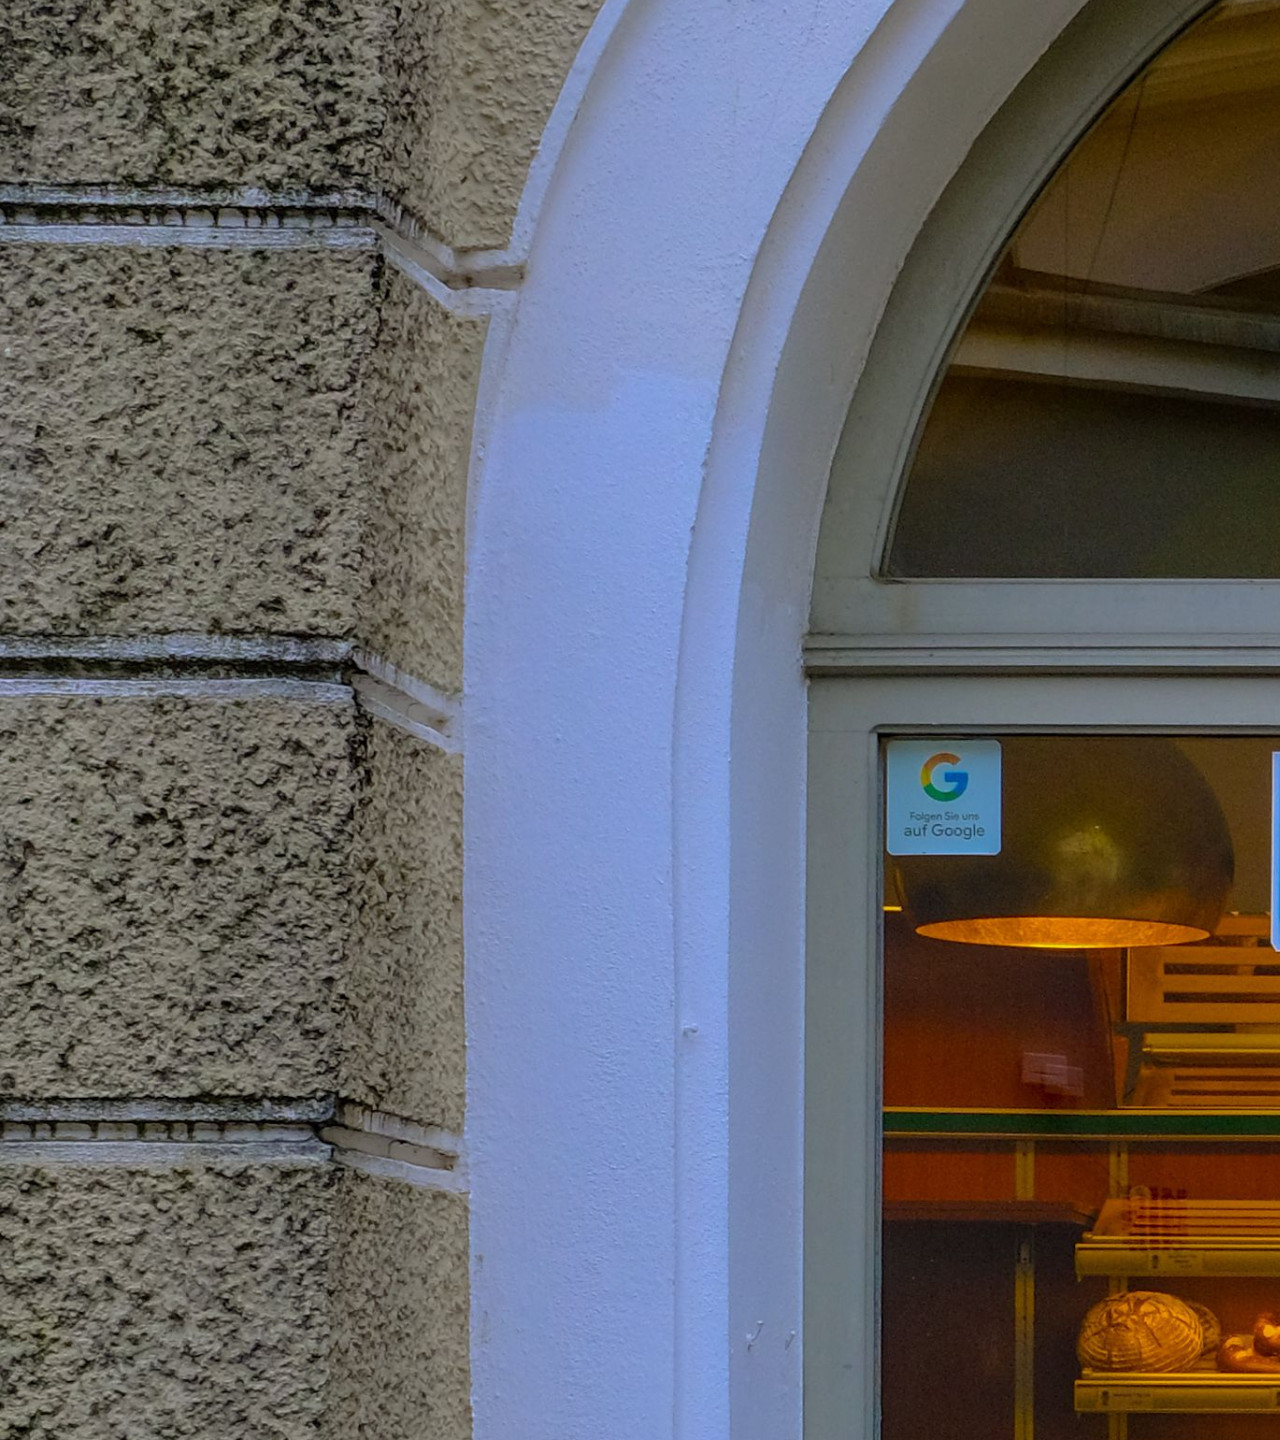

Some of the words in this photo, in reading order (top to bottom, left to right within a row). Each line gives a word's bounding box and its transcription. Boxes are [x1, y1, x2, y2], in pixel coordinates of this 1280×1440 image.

[909, 811, 943, 823] Folgen
[944, 811, 960, 821] Sie
[961, 812, 980, 821] uns
[903, 823, 928, 837] auf
[931, 823, 985, 840] Google
